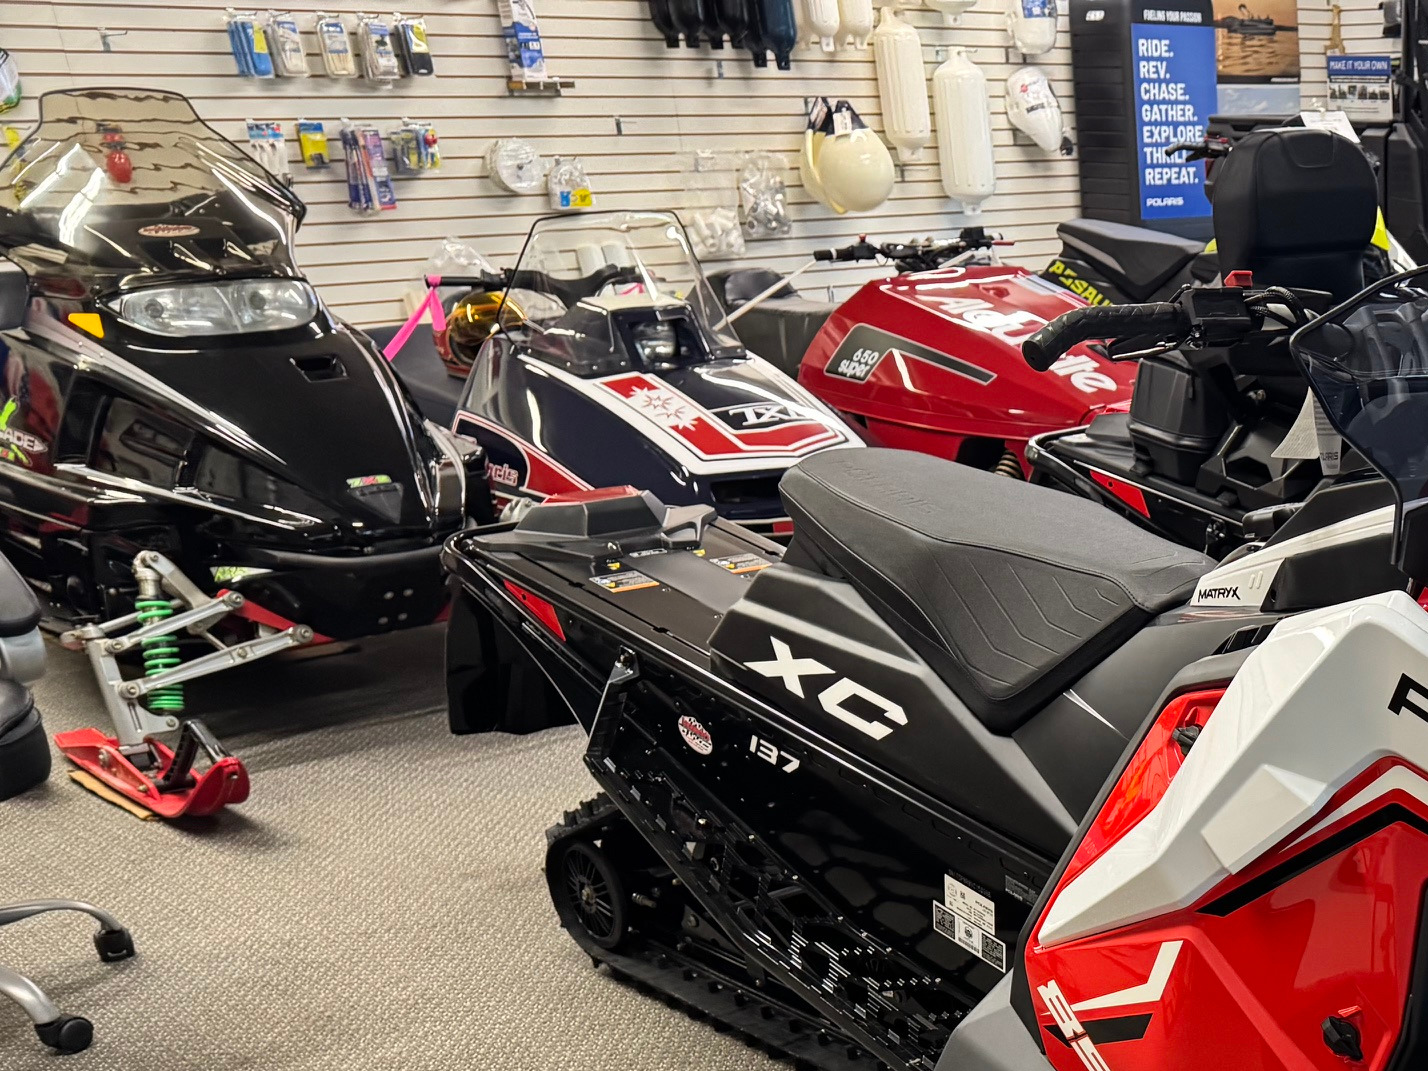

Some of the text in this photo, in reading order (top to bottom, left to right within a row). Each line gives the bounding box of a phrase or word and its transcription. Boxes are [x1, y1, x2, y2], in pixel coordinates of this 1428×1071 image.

[1138, 38, 1174, 58] RIDE.
[1139, 61, 1170, 79] REV.
[1329, 60, 1388, 70] MAKE IT YOUR OWN
[1140, 83, 1190, 101] CHASE.
[1141, 104, 1198, 122] GATHER.
[1145, 167, 1199, 185] REPEAT.
[1146, 196, 1184, 207] POLARIS
[852, 348, 880, 365] 650
[838, 359, 871, 378] super
[1198, 586, 1241, 603] MATRYX
[743, 635, 909, 741] XC
[749, 734, 800, 773] 137
